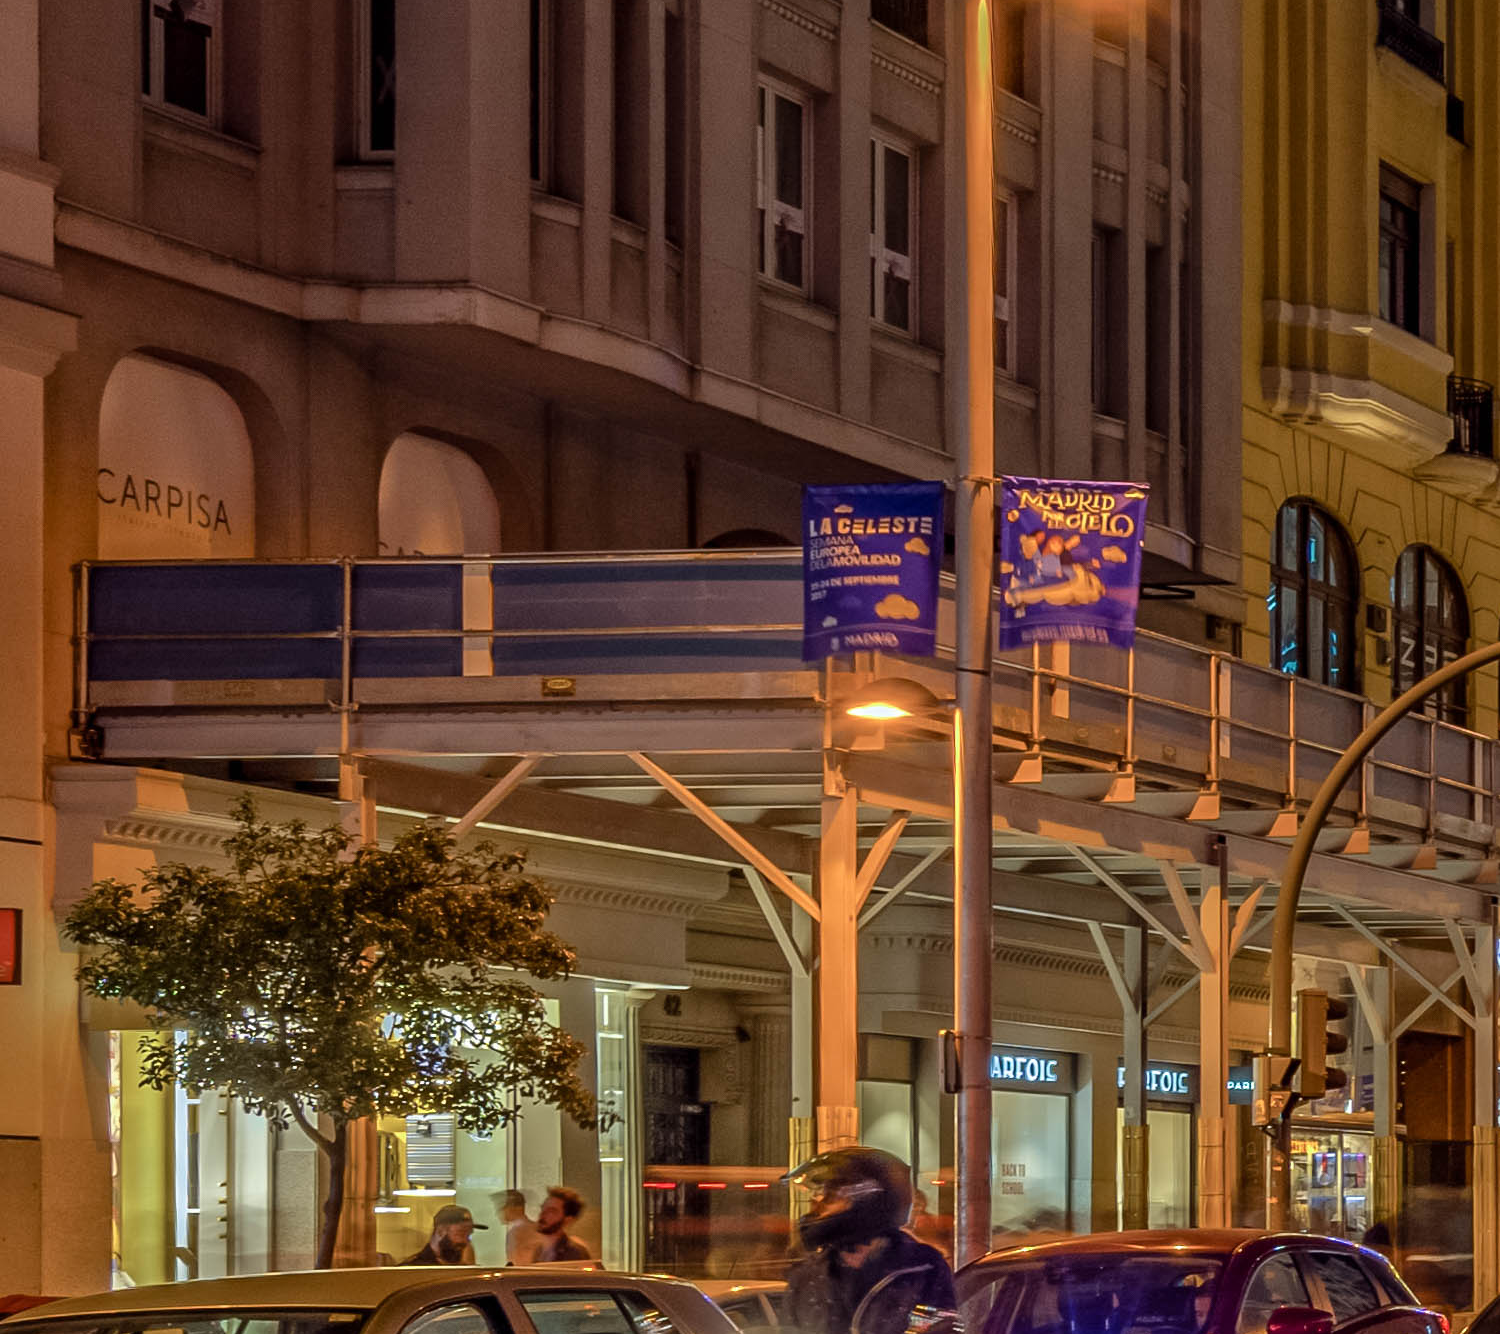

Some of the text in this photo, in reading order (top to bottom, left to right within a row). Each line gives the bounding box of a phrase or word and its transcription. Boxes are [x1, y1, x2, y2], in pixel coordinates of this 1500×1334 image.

[96, 468, 232, 536] CARPISA
[1018, 489, 1116, 513] MADRID
[809, 516, 933, 537] LA CELESTE
[1066, 512, 1135, 538] CIELO
[990, 1056, 1058, 1082] ARFOIS
[1002, 1164, 1016, 1178] BACK
